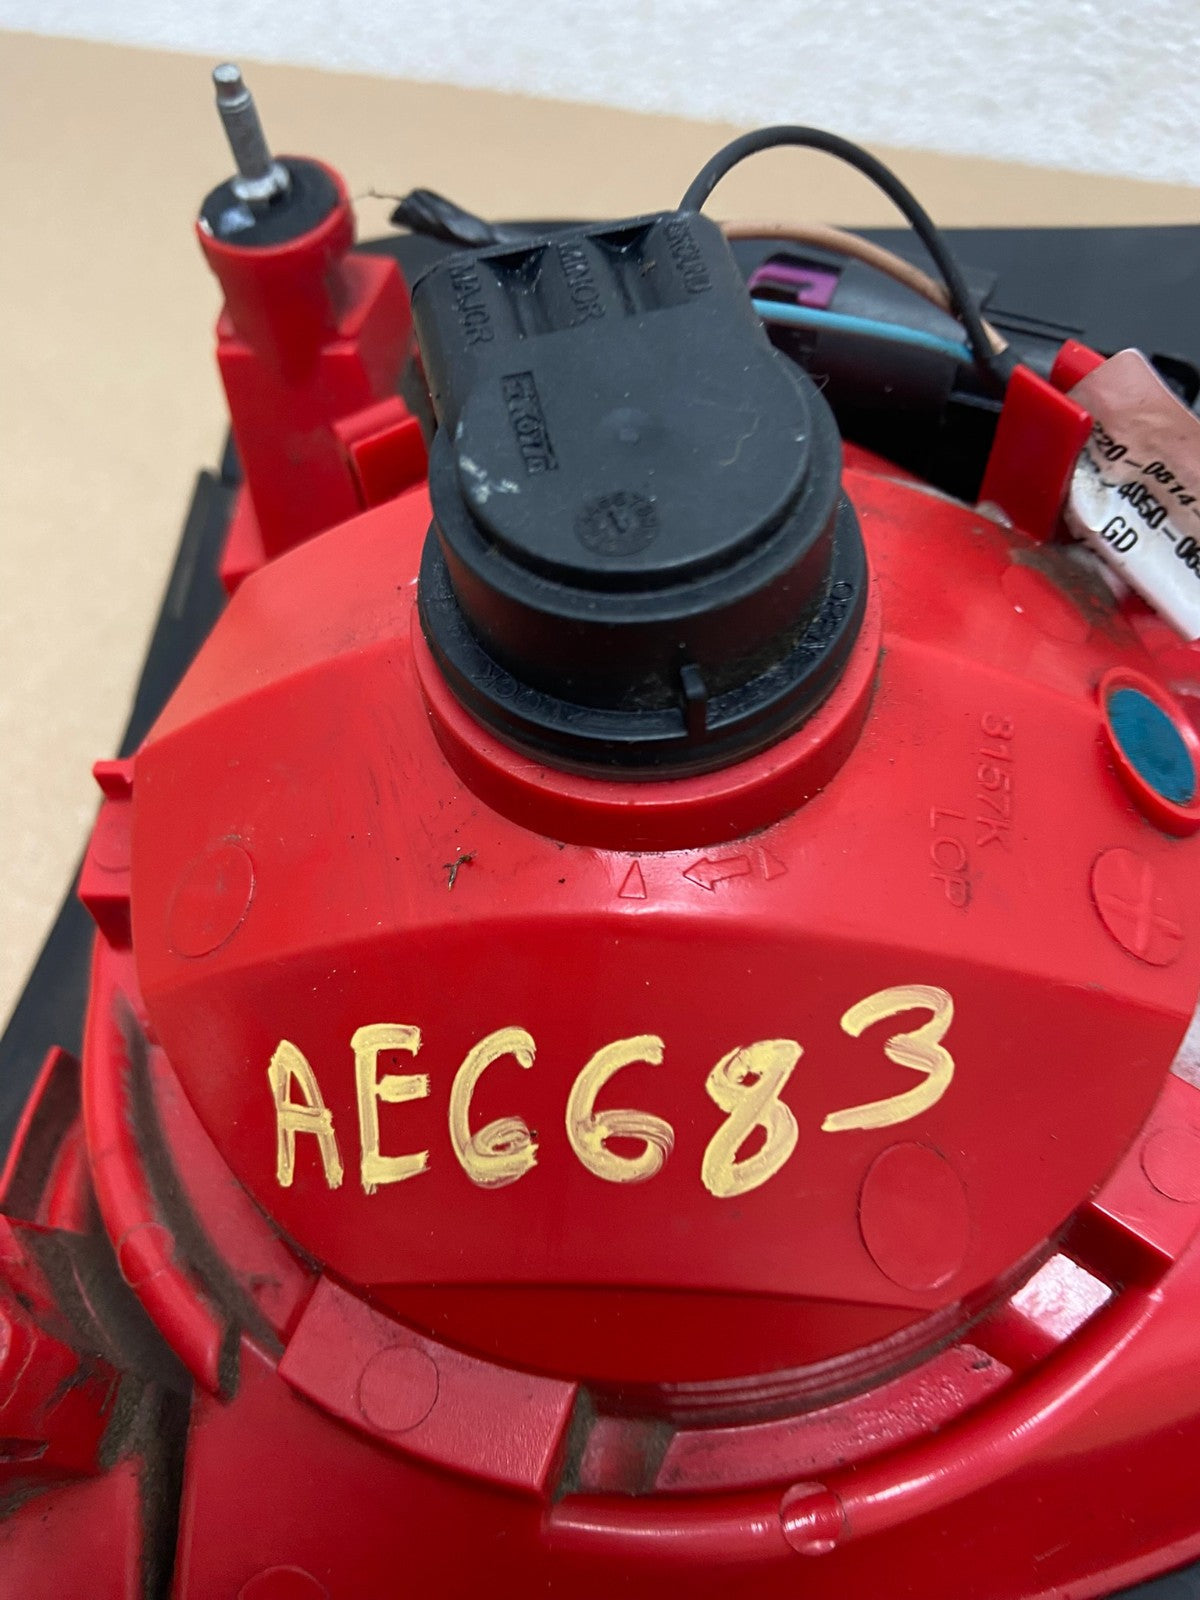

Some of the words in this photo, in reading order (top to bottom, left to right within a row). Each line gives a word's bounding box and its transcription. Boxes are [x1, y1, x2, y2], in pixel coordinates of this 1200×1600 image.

[447, 254, 496, 347] MAJOR
[557, 240, 607, 327] MINOR
[1101, 515, 1140, 554] GD
[976, 710, 1016, 853] 3157K
